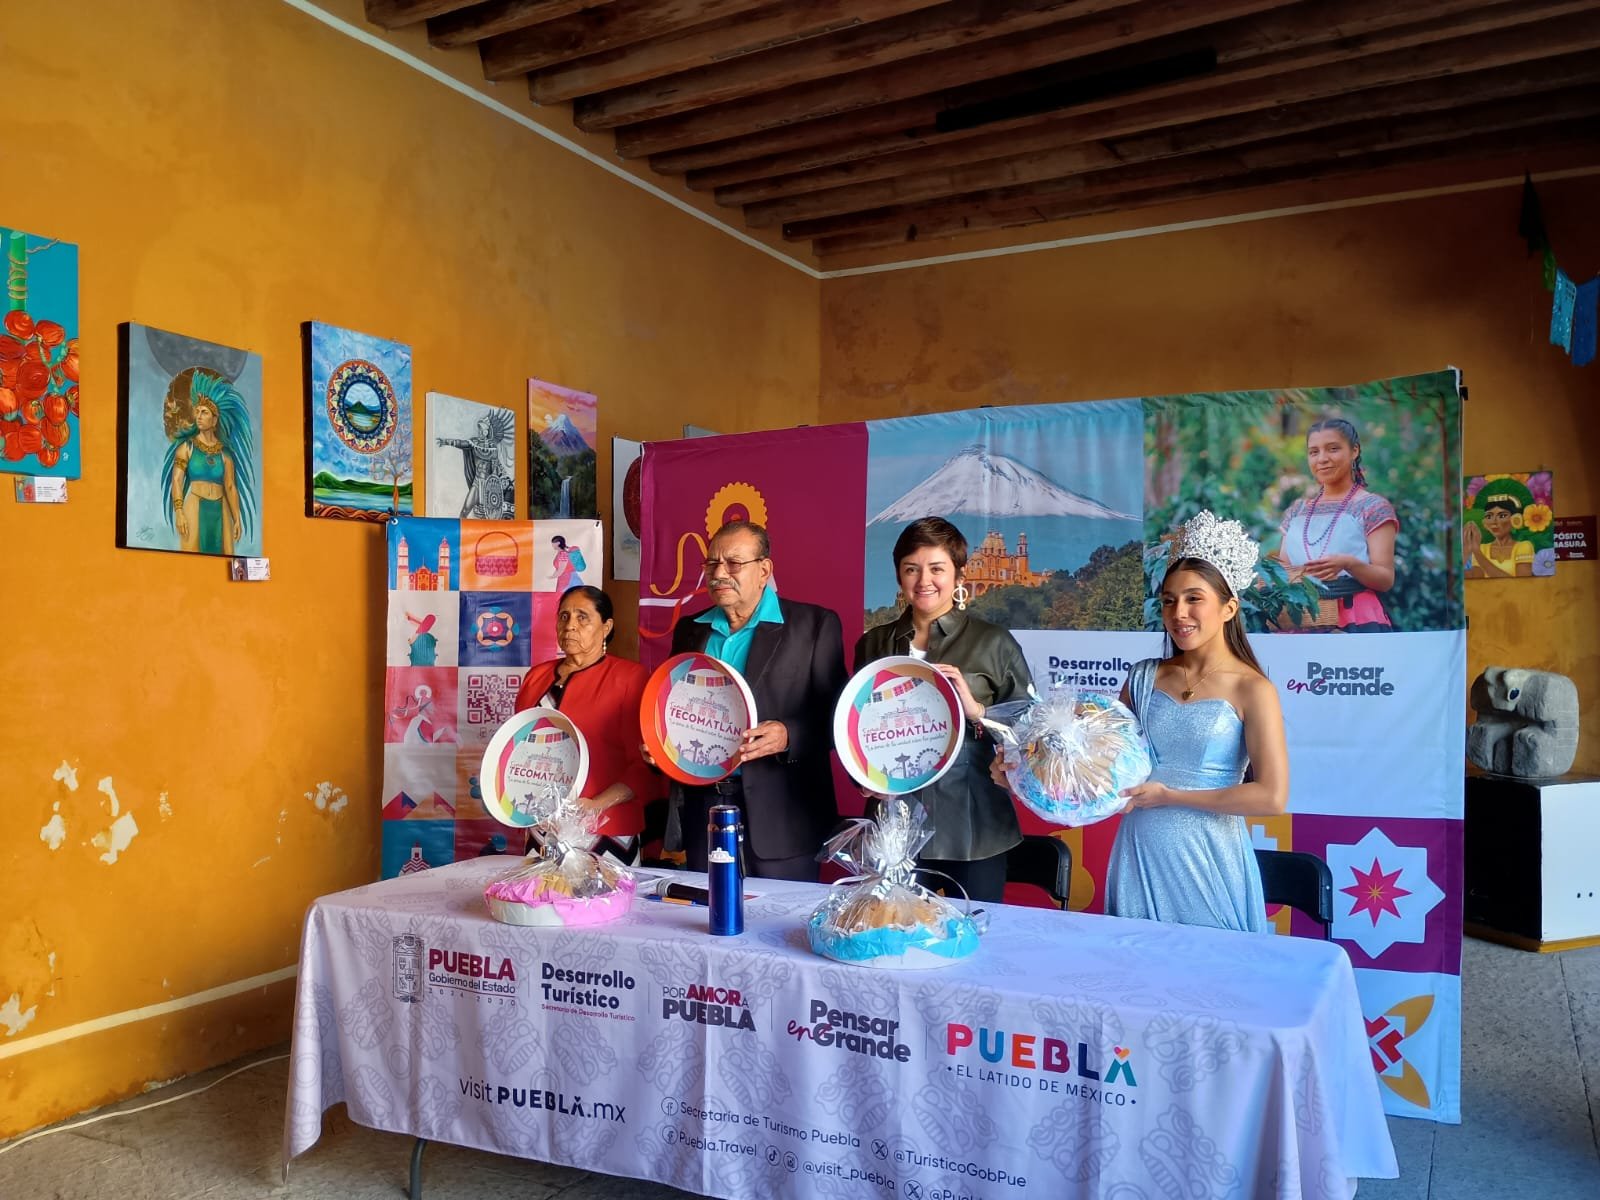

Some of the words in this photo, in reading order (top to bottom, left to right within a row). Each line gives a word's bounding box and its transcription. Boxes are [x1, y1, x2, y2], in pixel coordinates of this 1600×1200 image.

[1554, 532, 1584, 540] PÓSITO
[1048, 656, 1131, 672] Desarrollo
[1307, 661, 1385, 680] Pensar
[1286, 678, 1320, 695] en
[1310, 678, 1395, 696] Grande
[670, 707, 742, 737] TECOMATLÁN
[863, 719, 948, 744] TECOMATLÁN
[429, 948, 516, 982] PUEBLA
[541, 962, 636, 990] Desarrollo
[428, 972, 468, 987] Gobierno
[468, 979, 481, 990] del
[482, 980, 516, 994] Estado
[541, 983, 620, 1010] Turístico
[662, 986, 686, 998] POR
[686, 983, 743, 1007] AMOR
[742, 997, 750, 1008] A
[662, 998, 757, 1032] PUEBLA
[810, 999, 900, 1037] Pensar
[787, 1020, 826, 1041] en
[813, 1022, 912, 1063] Grande
[946, 1023, 1138, 1087] PUEBLA
[956, 1064, 973, 1078] EL
[979, 1068, 1032, 1089] LATIDO
[1039, 1079, 1059, 1093] DE
[1066, 1083, 1126, 1106] MÉXICO
[679, 1132, 757, 1156] Puebla.Travel
[743, 1114, 760, 1127] de
[763, 1116, 808, 1141] Turismo
[811, 1129, 861, 1148] Puebla
[802, 1161, 896, 1191] @visit_puebla
[893, 1150, 1027, 1187] @TuristicoGobPue
